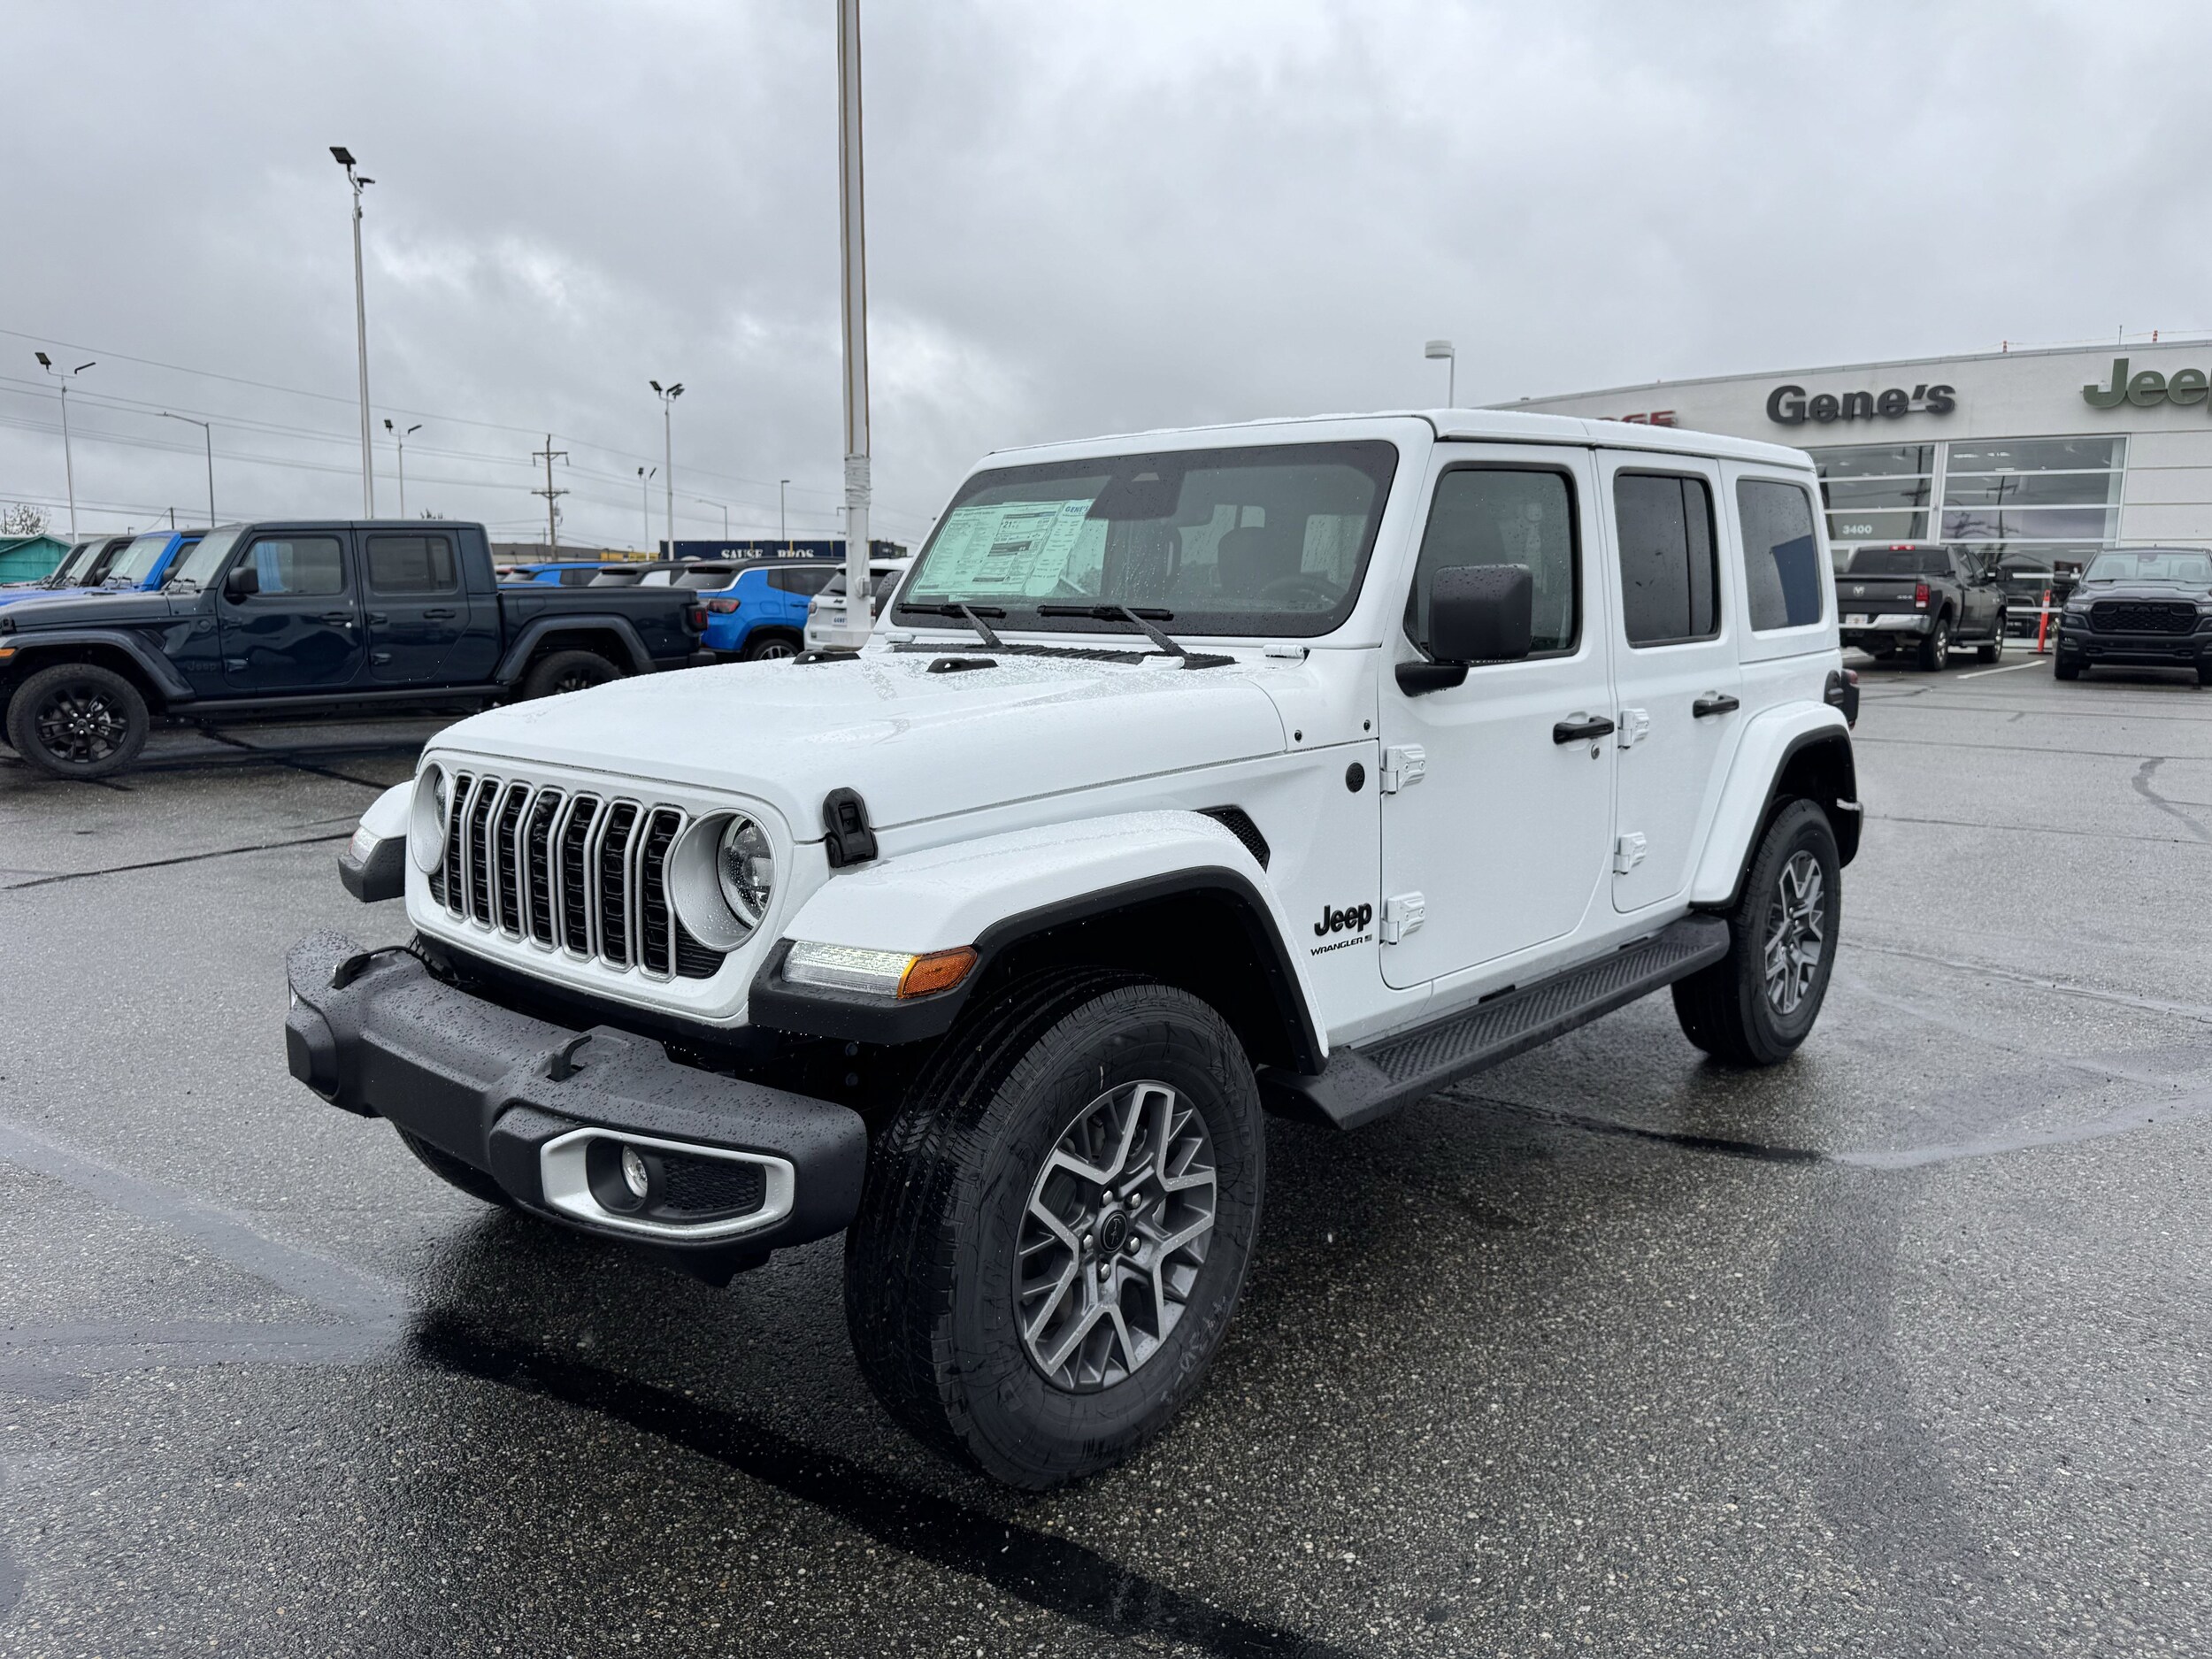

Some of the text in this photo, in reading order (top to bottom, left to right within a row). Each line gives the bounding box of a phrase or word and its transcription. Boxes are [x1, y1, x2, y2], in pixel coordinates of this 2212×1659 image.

[2083, 357, 2212, 414] Jee
[1766, 384, 1956, 426] Gene's
[1842, 524, 1872, 535] 3400
[720, 549, 763, 559] SAUSE
[1314, 902, 1372, 937] Jeep
[1310, 936, 1363, 956] WRANGLER
